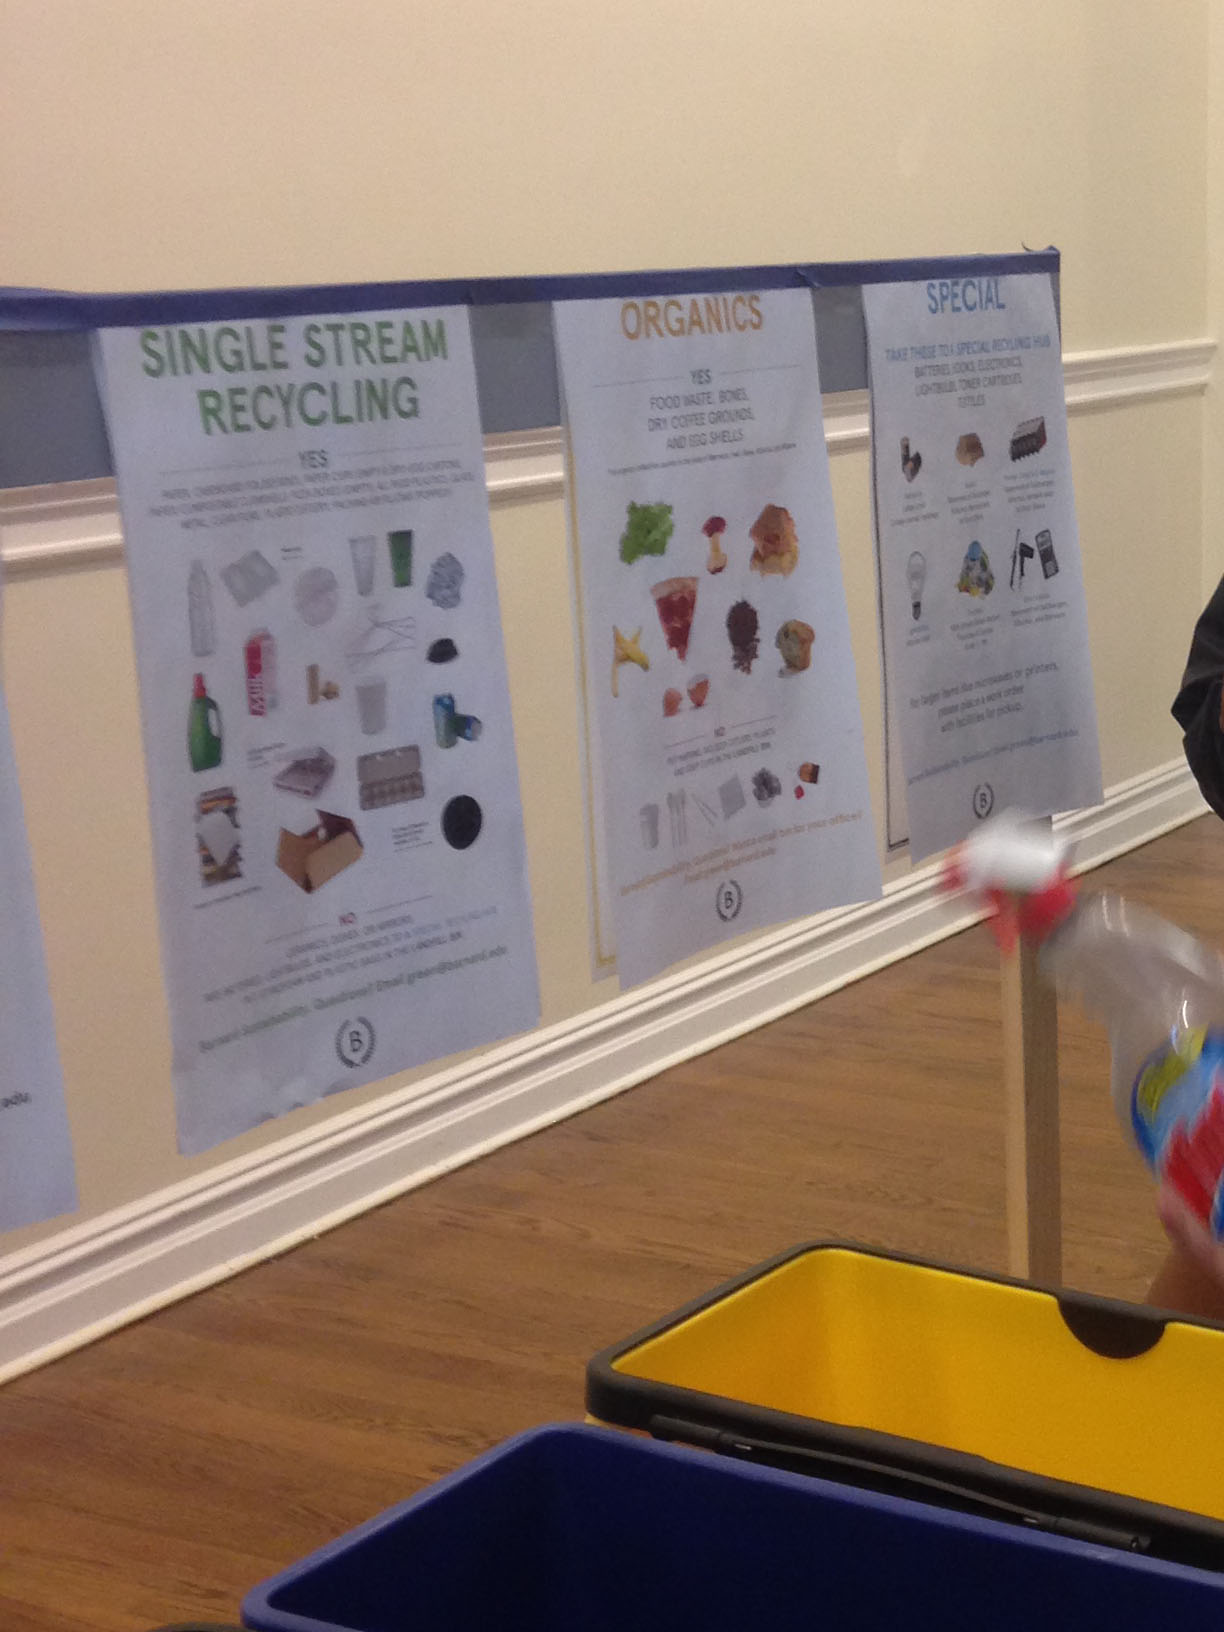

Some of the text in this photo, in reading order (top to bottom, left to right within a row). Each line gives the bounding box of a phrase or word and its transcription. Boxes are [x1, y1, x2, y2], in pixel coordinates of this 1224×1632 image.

[927, 279, 1006, 314] SPECIAL
[620, 294, 763, 340] ORGANICS
[140, 319, 448, 378] SINGLE STREAM
[690, 369, 712, 385] YES
[197, 376, 419, 436] RECYCLING
[650, 395, 681, 410] FOOD
[648, 417, 668, 431] DRY
[671, 412, 705, 429] COFFEE
[666, 428, 744, 450] AND EGG SHELLS
[299, 450, 328, 469] YES
[723, 890, 734, 909] B
[349, 1029, 363, 1052] B
